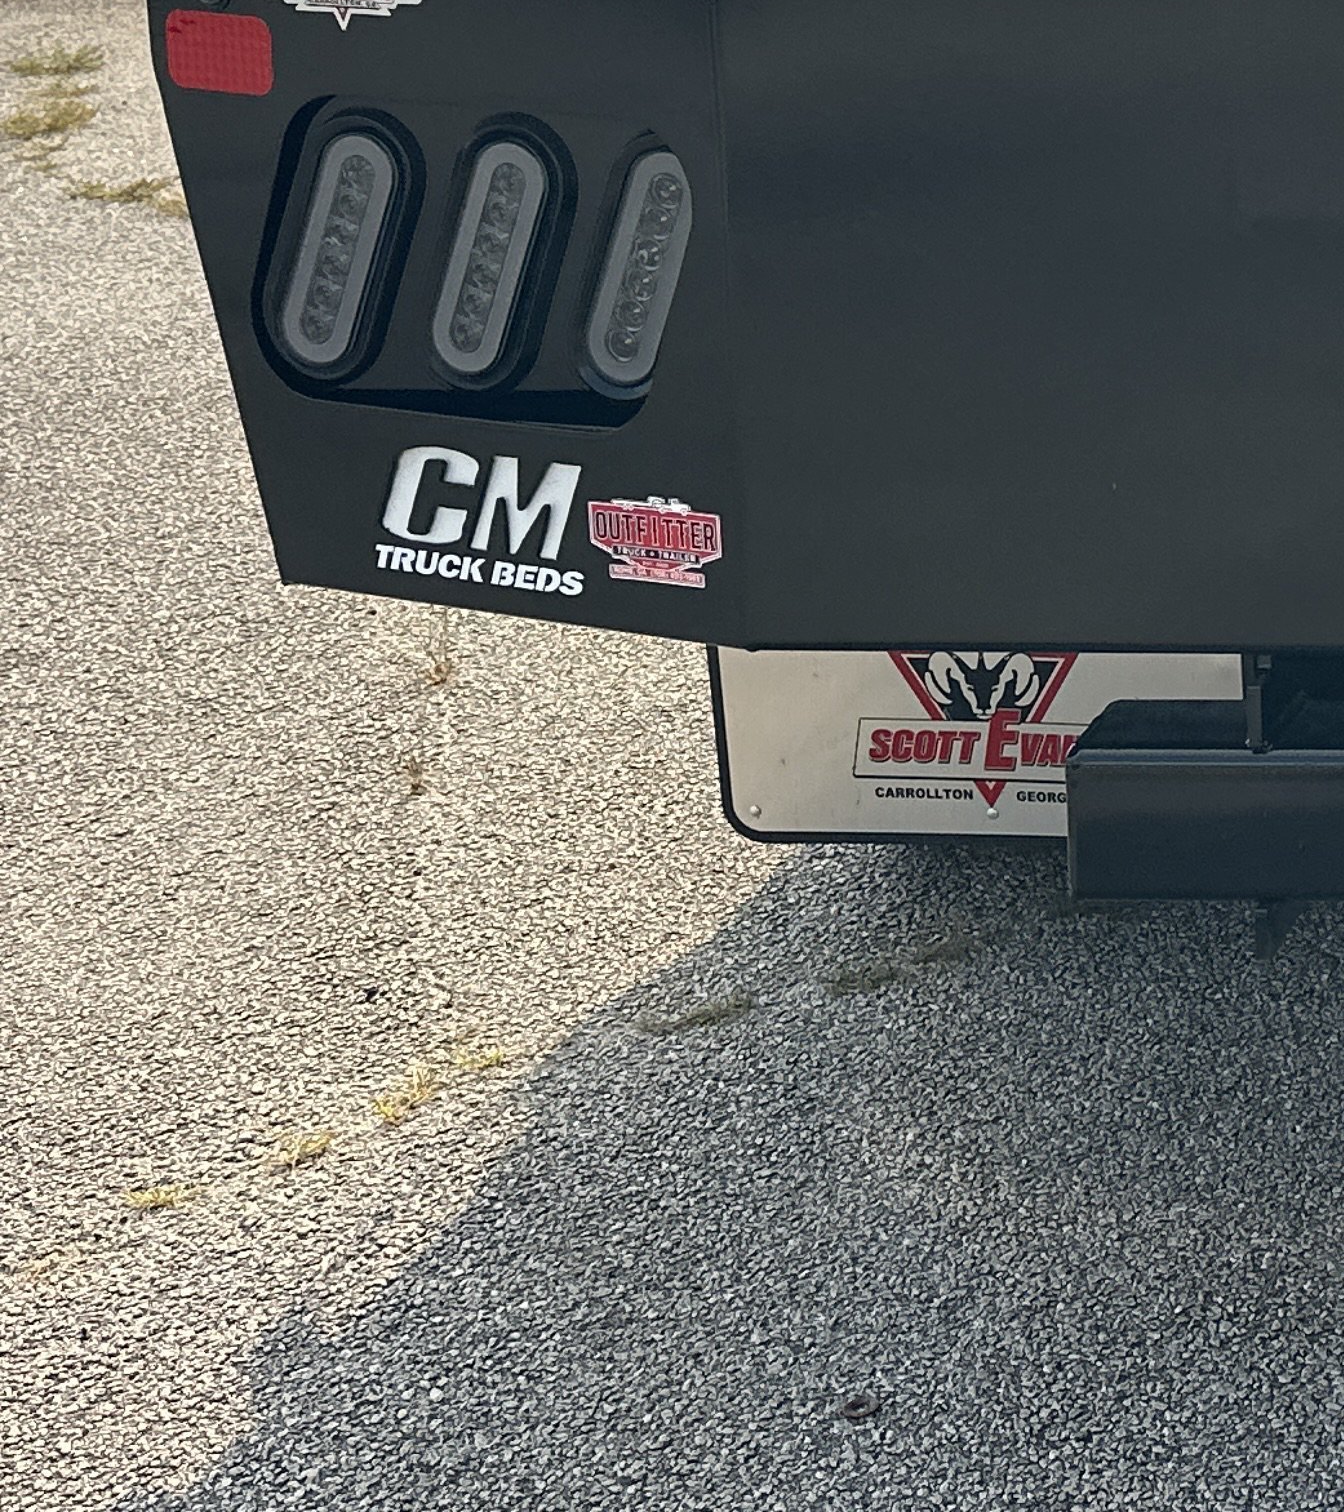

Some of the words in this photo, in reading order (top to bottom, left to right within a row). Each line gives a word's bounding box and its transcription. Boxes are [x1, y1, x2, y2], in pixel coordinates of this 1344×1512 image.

[382, 445, 582, 561] CM
[594, 510, 716, 552] OUTFITTER
[375, 543, 485, 584] TRUCK
[490, 560, 585, 596] BEDS
[869, 728, 982, 765] SCOTT
[875, 786, 975, 800] CARROLLTON
[1016, 790, 1067, 804] GEORG
